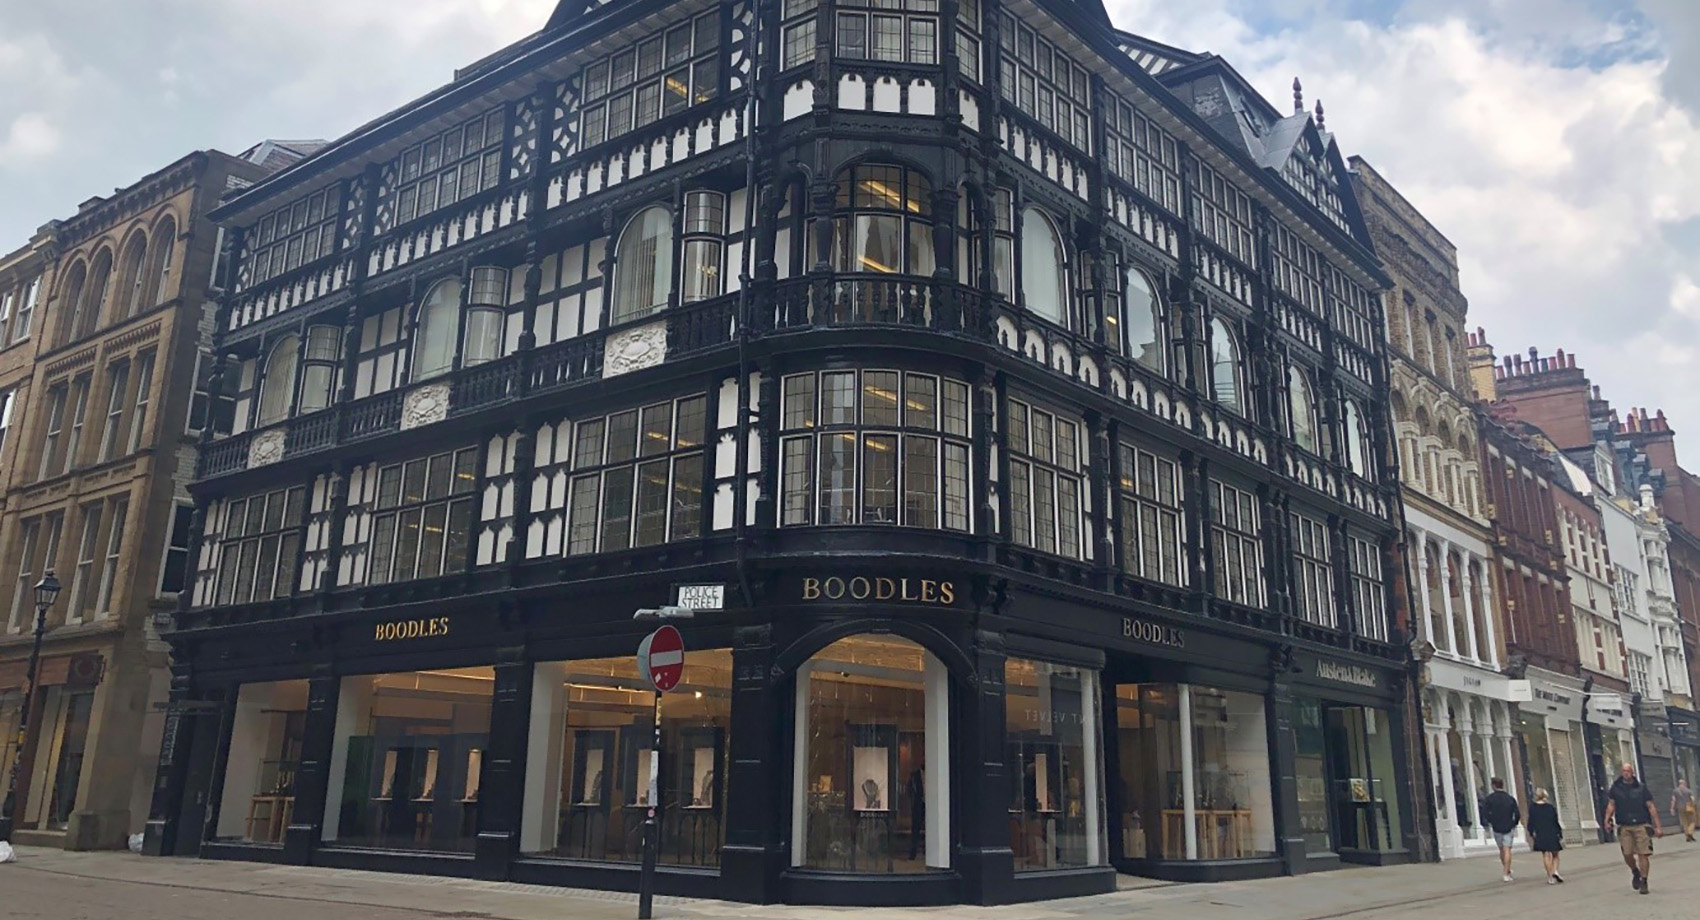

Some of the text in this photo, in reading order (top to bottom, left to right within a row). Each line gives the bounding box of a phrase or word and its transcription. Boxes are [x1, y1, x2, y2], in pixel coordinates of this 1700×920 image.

[684, 586, 719, 599] POLICE
[802, 576, 955, 604] BOODLES
[682, 598, 718, 608] STREET
[375, 617, 449, 641] BOODLES
[1122, 617, 1185, 648] BOODLES
